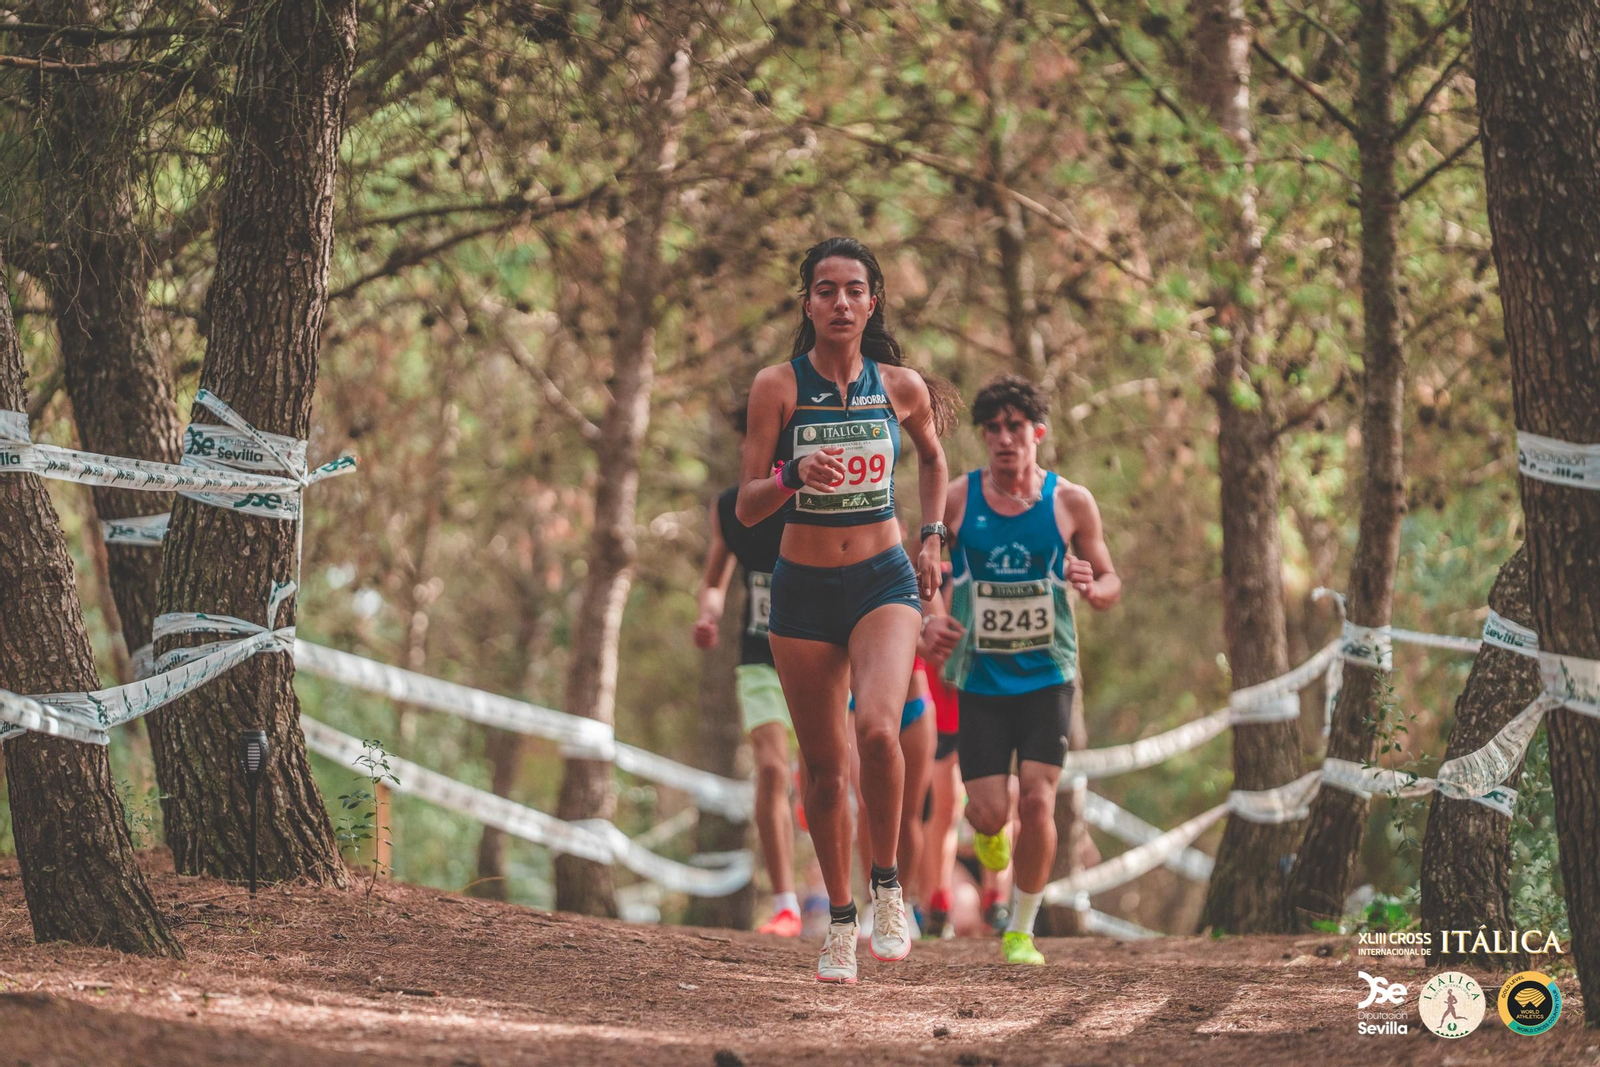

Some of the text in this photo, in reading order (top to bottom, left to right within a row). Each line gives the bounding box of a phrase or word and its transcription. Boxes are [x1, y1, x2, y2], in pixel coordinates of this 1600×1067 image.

[852, 394, 887, 406] ANDORRA
[823, 424, 867, 438] ITÁLICA
[217, 446, 264, 463] Sevilla
[983, 608, 1048, 632] 8243
